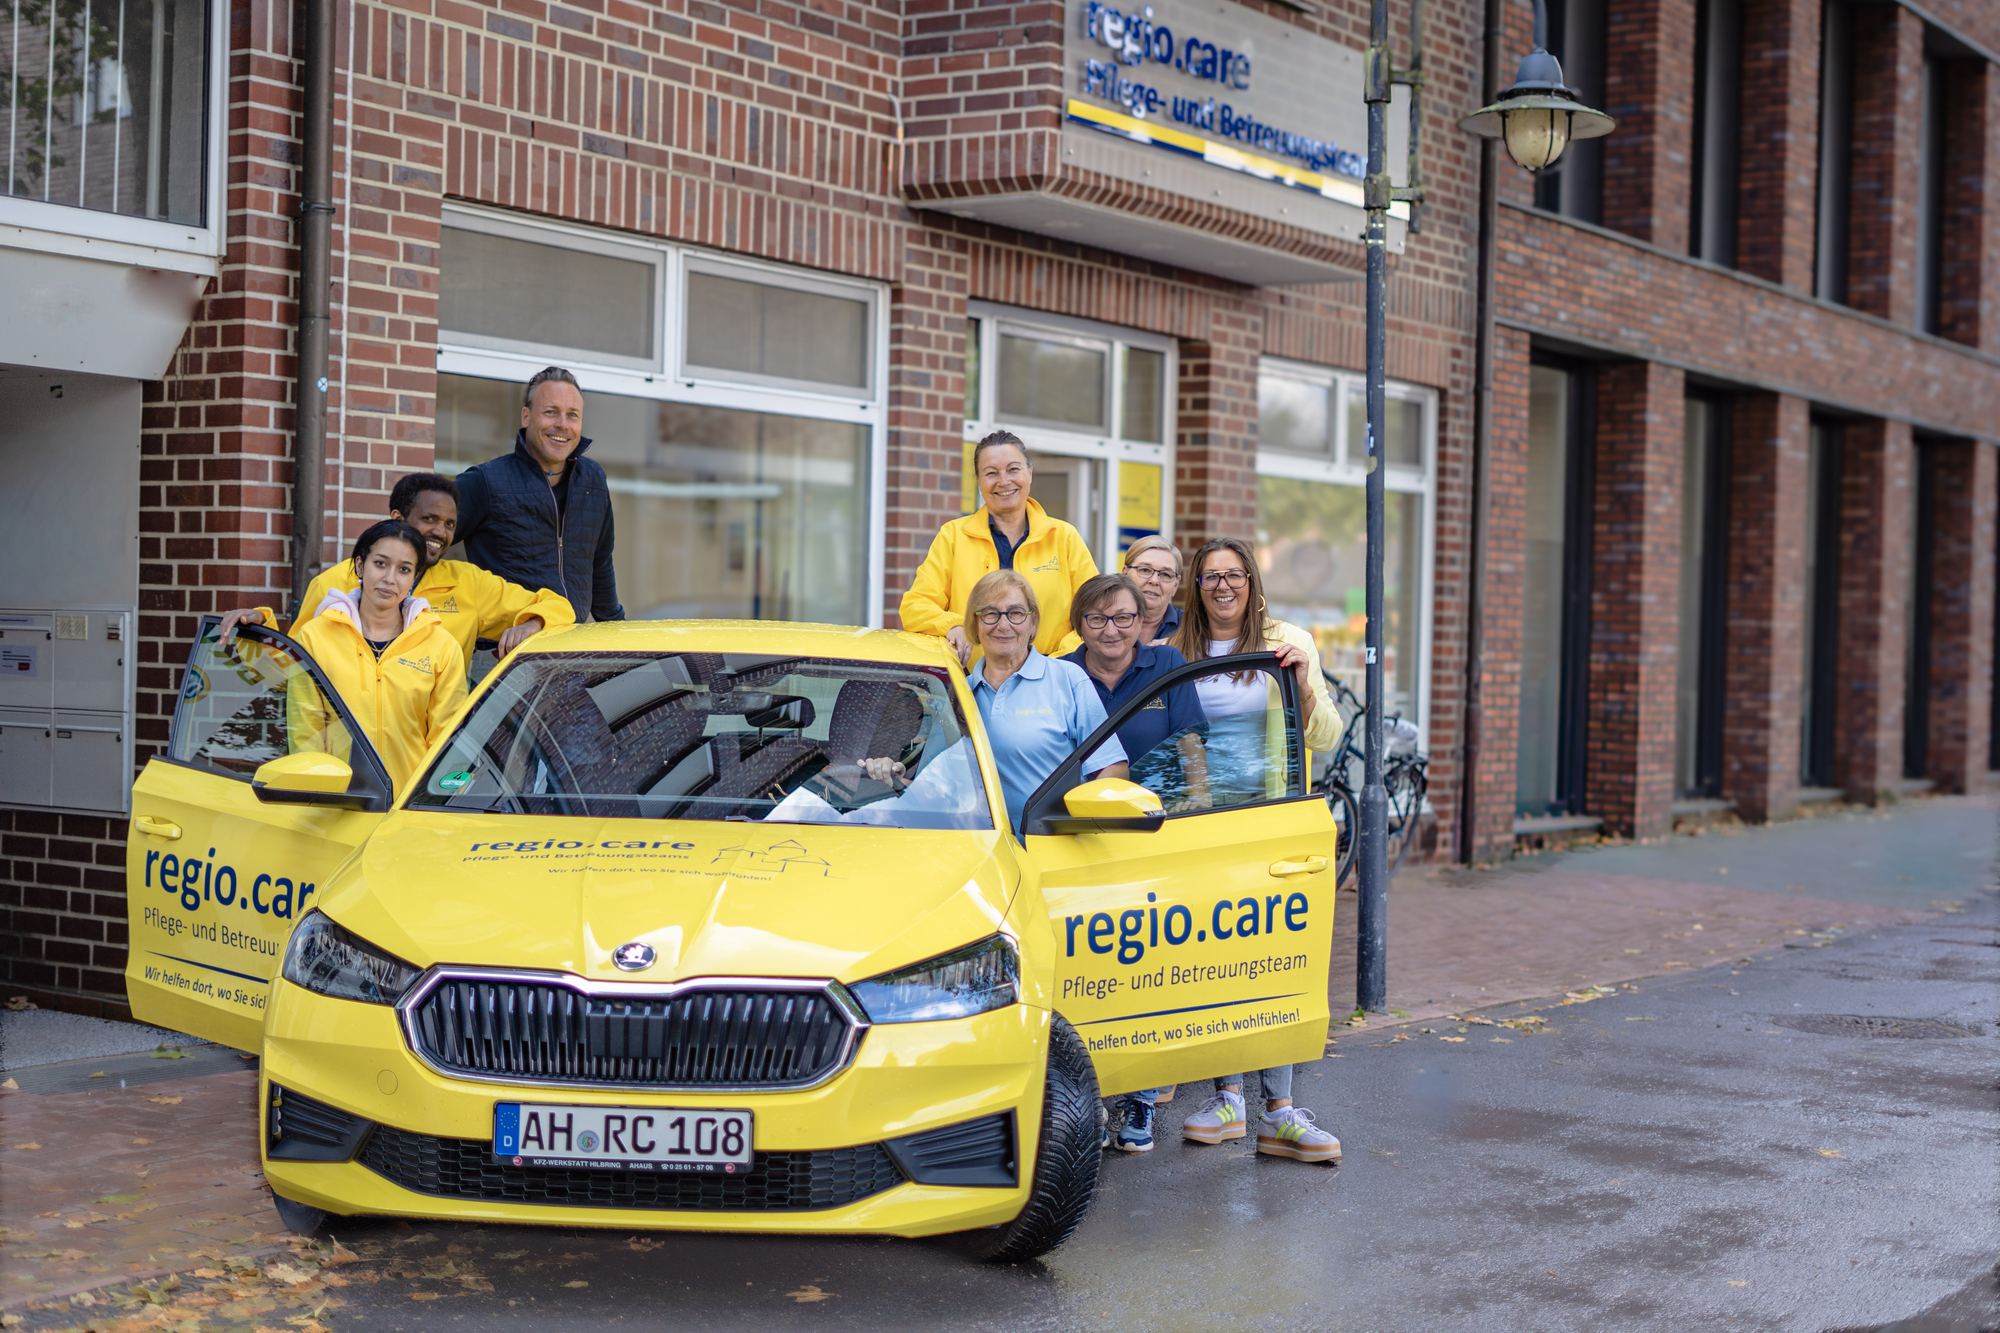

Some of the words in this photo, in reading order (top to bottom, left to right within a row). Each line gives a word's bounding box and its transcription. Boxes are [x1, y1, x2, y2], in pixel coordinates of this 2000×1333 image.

[1088, 1, 1251, 90] regio.care
[1087, 58, 1167, 119] Pflege-
[1173, 95, 1215, 131] und
[1220, 103, 1367, 180] Betreuungstea
[470, 838, 695, 852] regio.care
[145, 847, 315, 919] regio.car
[144, 907, 187, 937] Pflege-
[192, 922, 217, 943] und
[1065, 892, 1308, 965] regio.care
[145, 965, 161, 982] Wir
[162, 969, 190, 986] helfen
[192, 979, 214, 998] dort,
[217, 987, 232, 1000] wo
[233, 988, 248, 1006] Sie
[1063, 975, 1124, 1000] Pflege-
[1131, 965, 1164, 990] und
[1171, 953, 1307, 986] Betreuungsteam
[1089, 1033, 1128, 1051] helfen
[1131, 1029, 1161, 1046] dort,
[1164, 1027, 1182, 1041] wo
[1186, 1022, 1203, 1037] Sie
[1206, 1019, 1229, 1035] sich
[1232, 1008, 1301, 1031] wohlfühlen!
[503, 1135, 513, 1147] D
[521, 1111, 574, 1152] AH
[603, 1114, 656, 1154] RC
[668, 1116, 744, 1157] 108
[533, 1159, 588, 1167] KFZ-WERKSTATT
[590, 1160, 621, 1168] HILBRING
